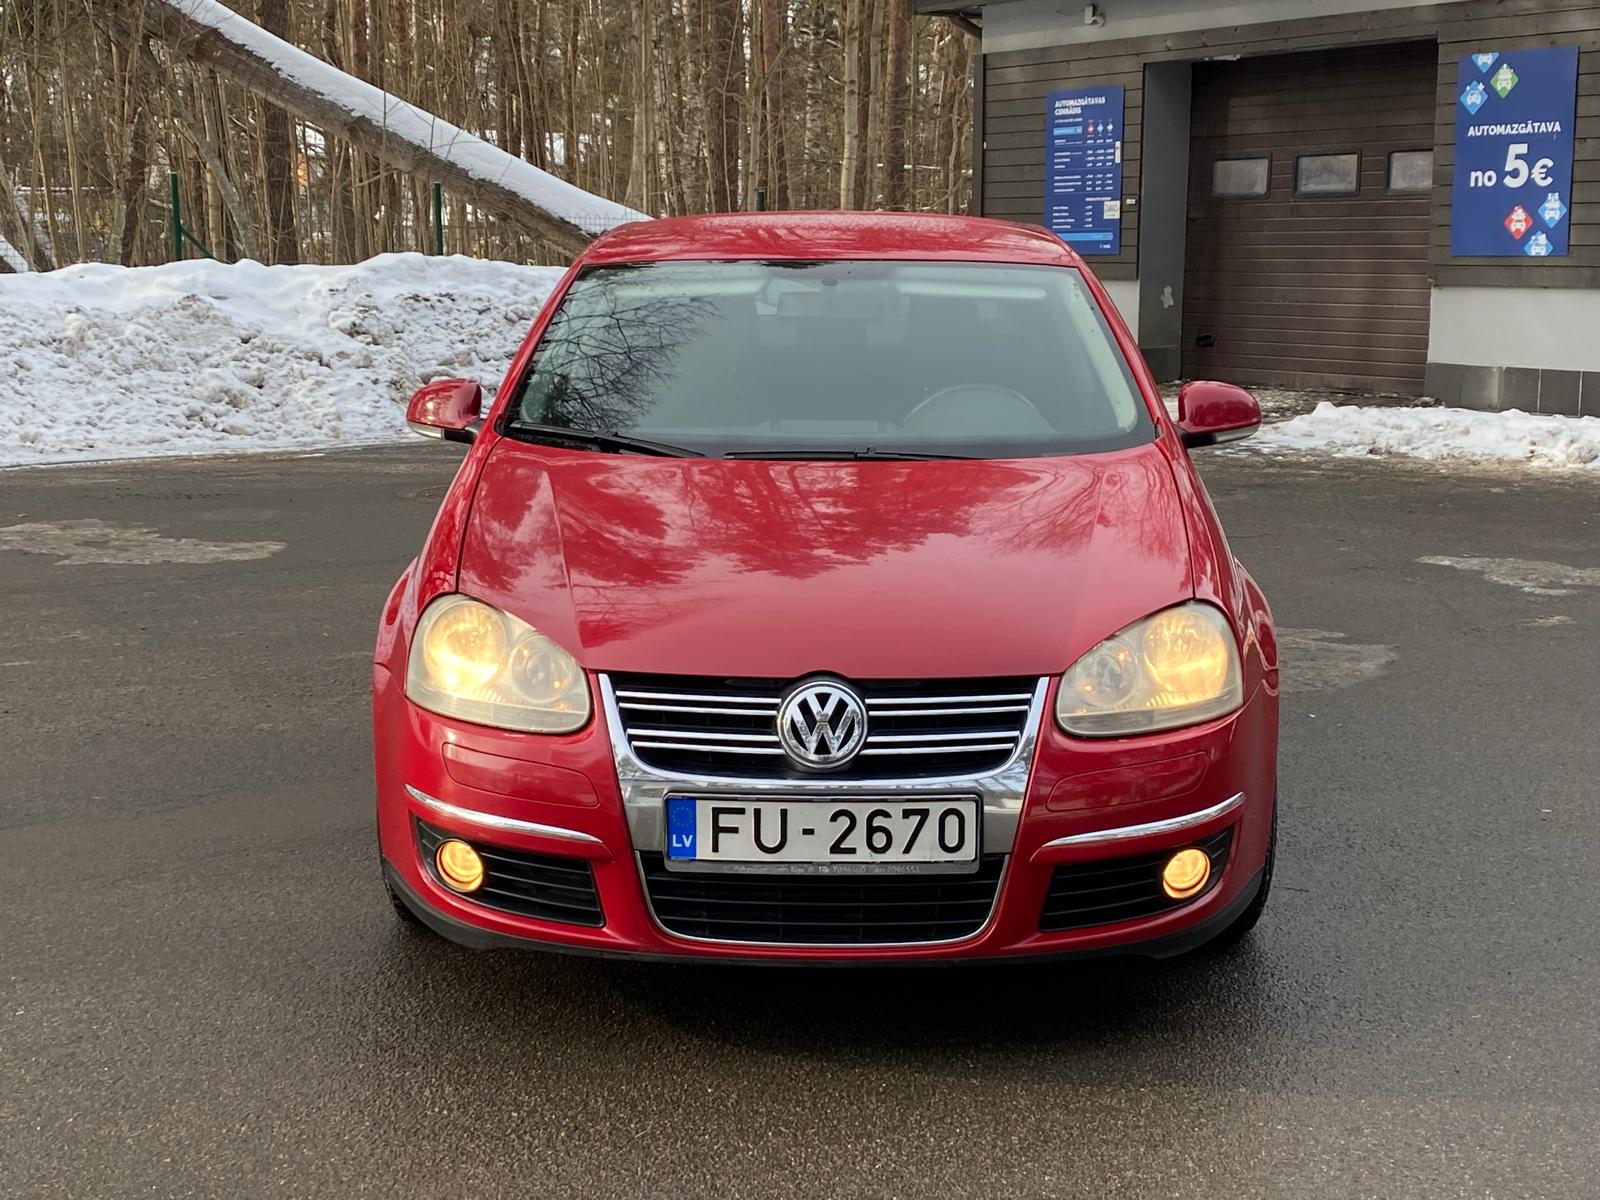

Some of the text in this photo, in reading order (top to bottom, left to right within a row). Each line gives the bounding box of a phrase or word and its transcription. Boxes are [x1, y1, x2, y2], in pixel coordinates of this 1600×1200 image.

[1467, 120, 1562, 137] AUTOMAZGĀTAVA
[1469, 170, 1498, 188] no
[711, 806, 966, 855] FU-2670
[671, 833, 693, 848] LV
